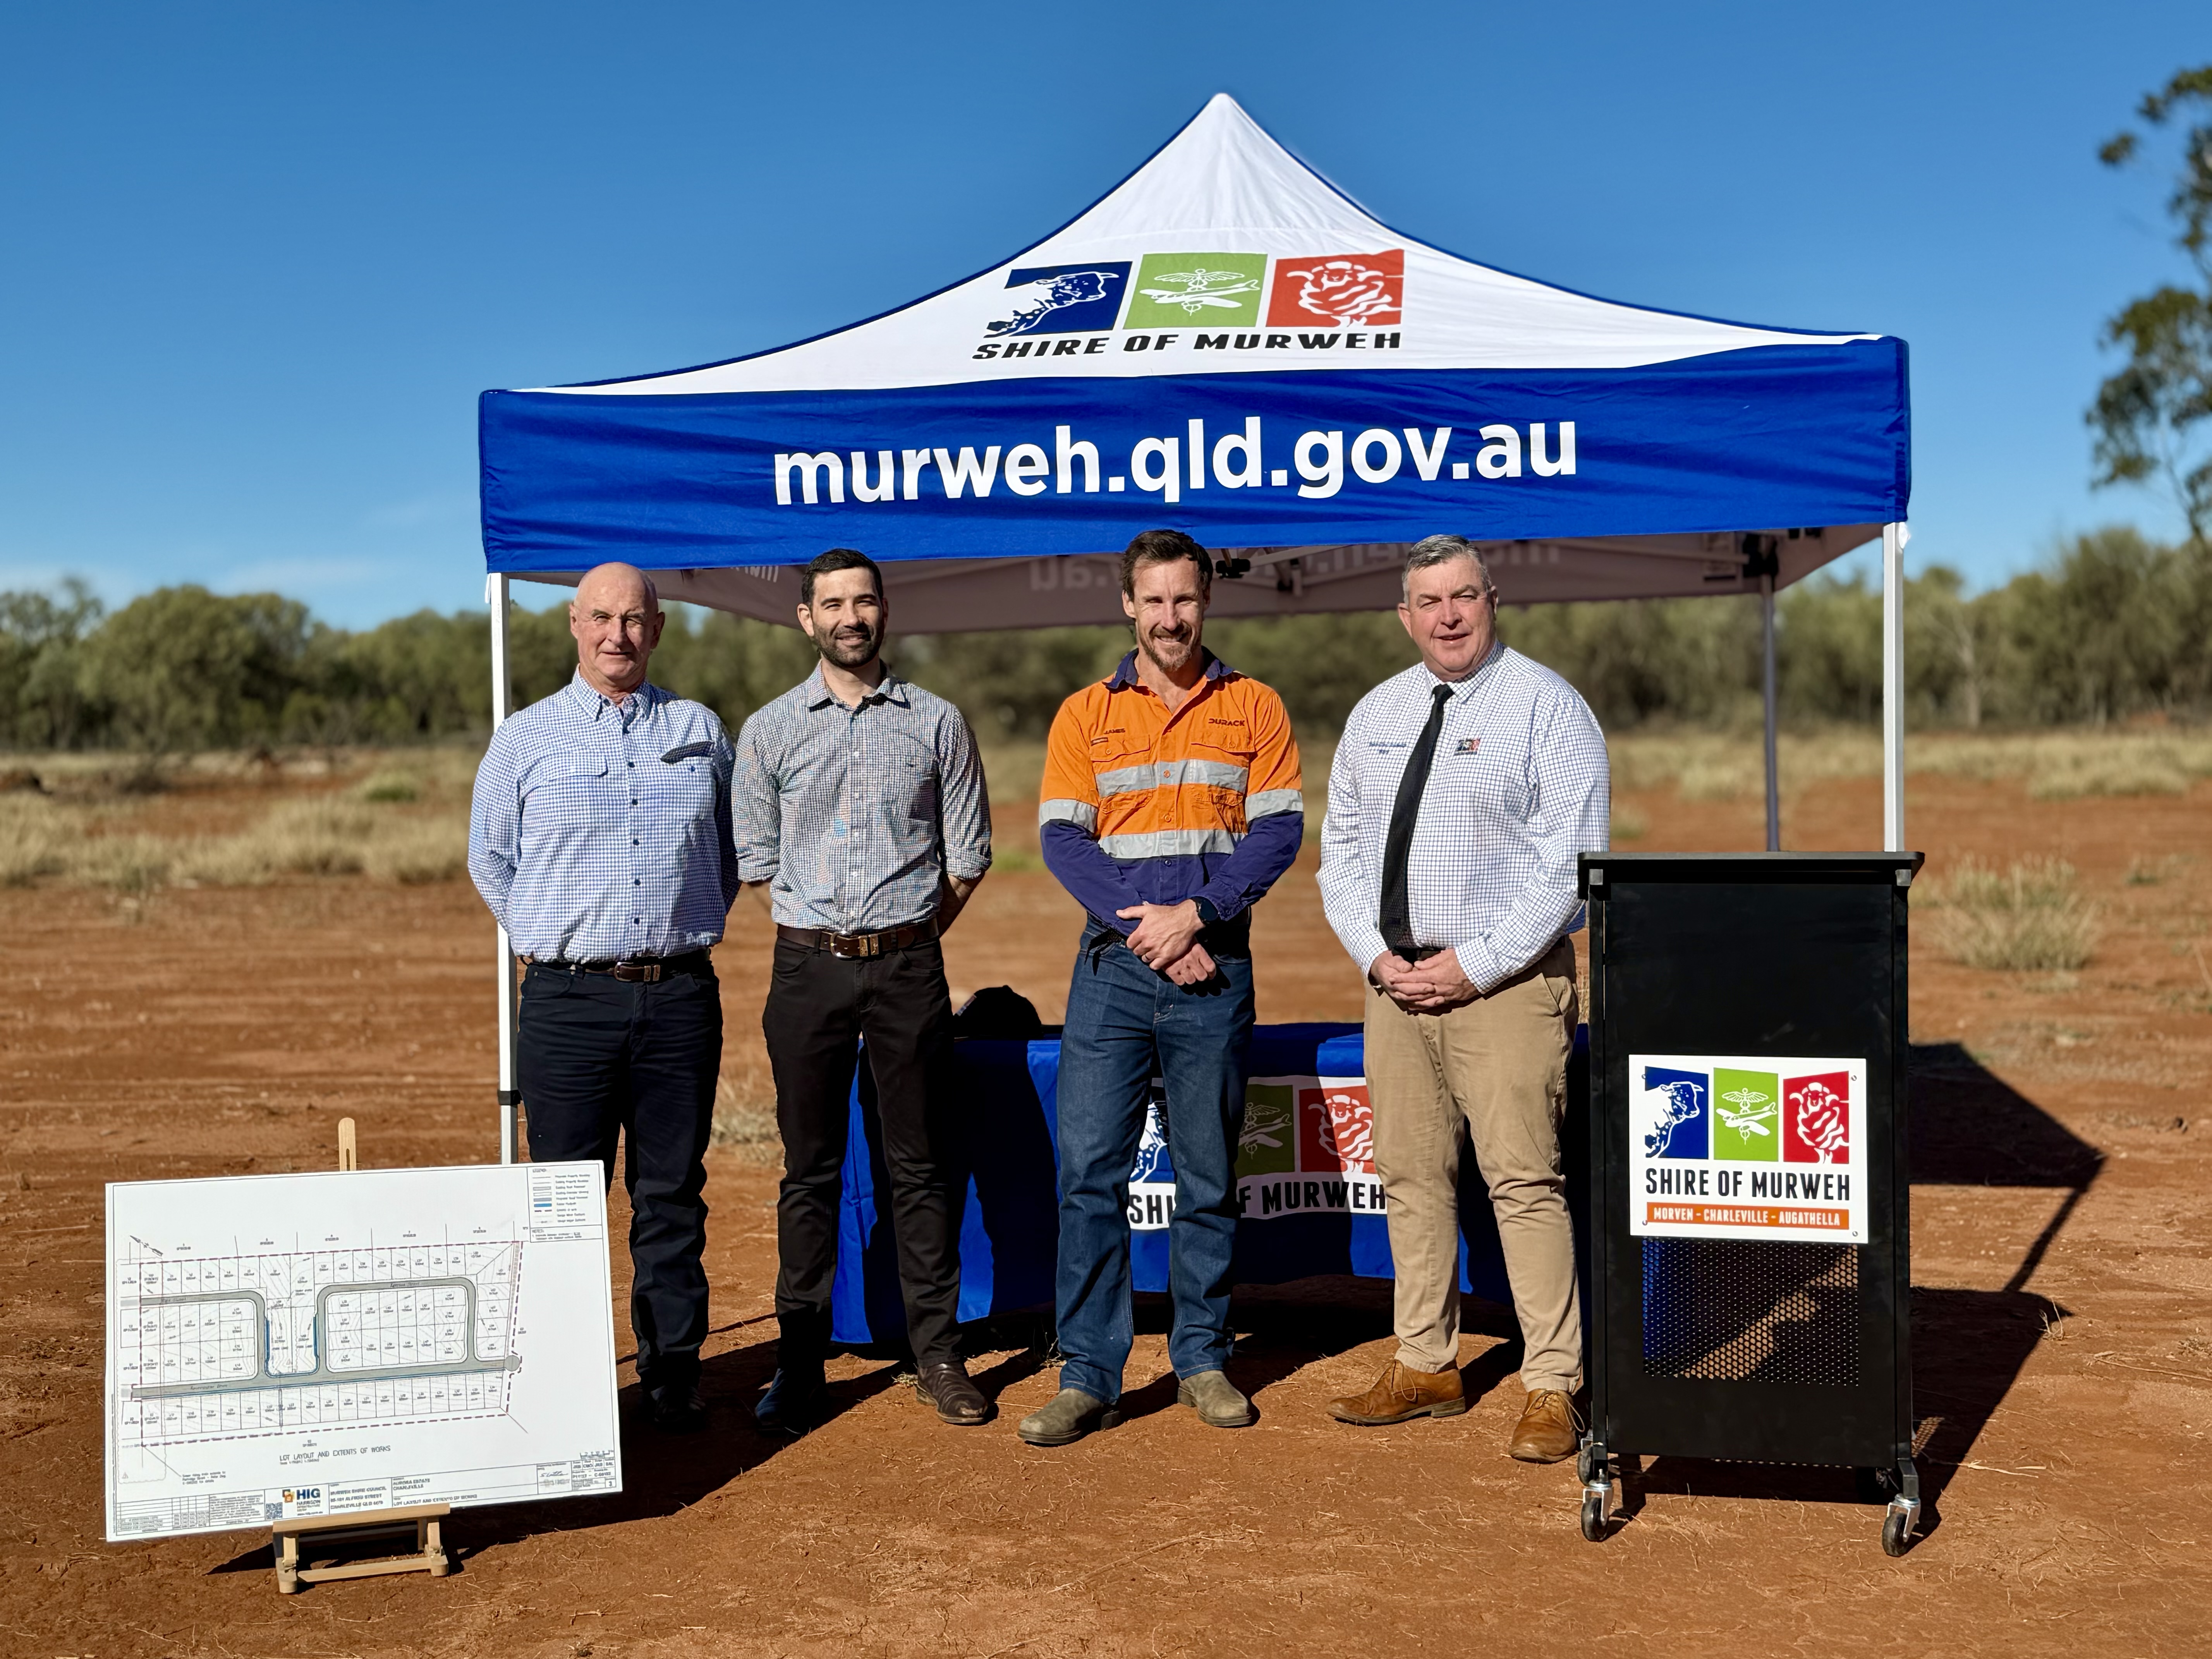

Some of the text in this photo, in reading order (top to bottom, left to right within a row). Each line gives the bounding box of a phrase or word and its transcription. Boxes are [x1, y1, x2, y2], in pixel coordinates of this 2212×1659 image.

[972, 333, 1400, 359] SHIRE OF MURWEH
[775, 416, 1576, 505] murweh.qld.gov.au
[1208, 718, 1245, 726] DURACK
[1646, 1168, 1850, 1200] SHIRE OF MURWEH
[1129, 1181, 1386, 1224] SHI F MURWEH
[1654, 1207, 1693, 1221] MORVEN
[1704, 1209, 1768, 1223] CHARLEVILLE
[1779, 1211, 1840, 1226] AUGATHELLA
[297, 1488, 321, 1500] HIG
